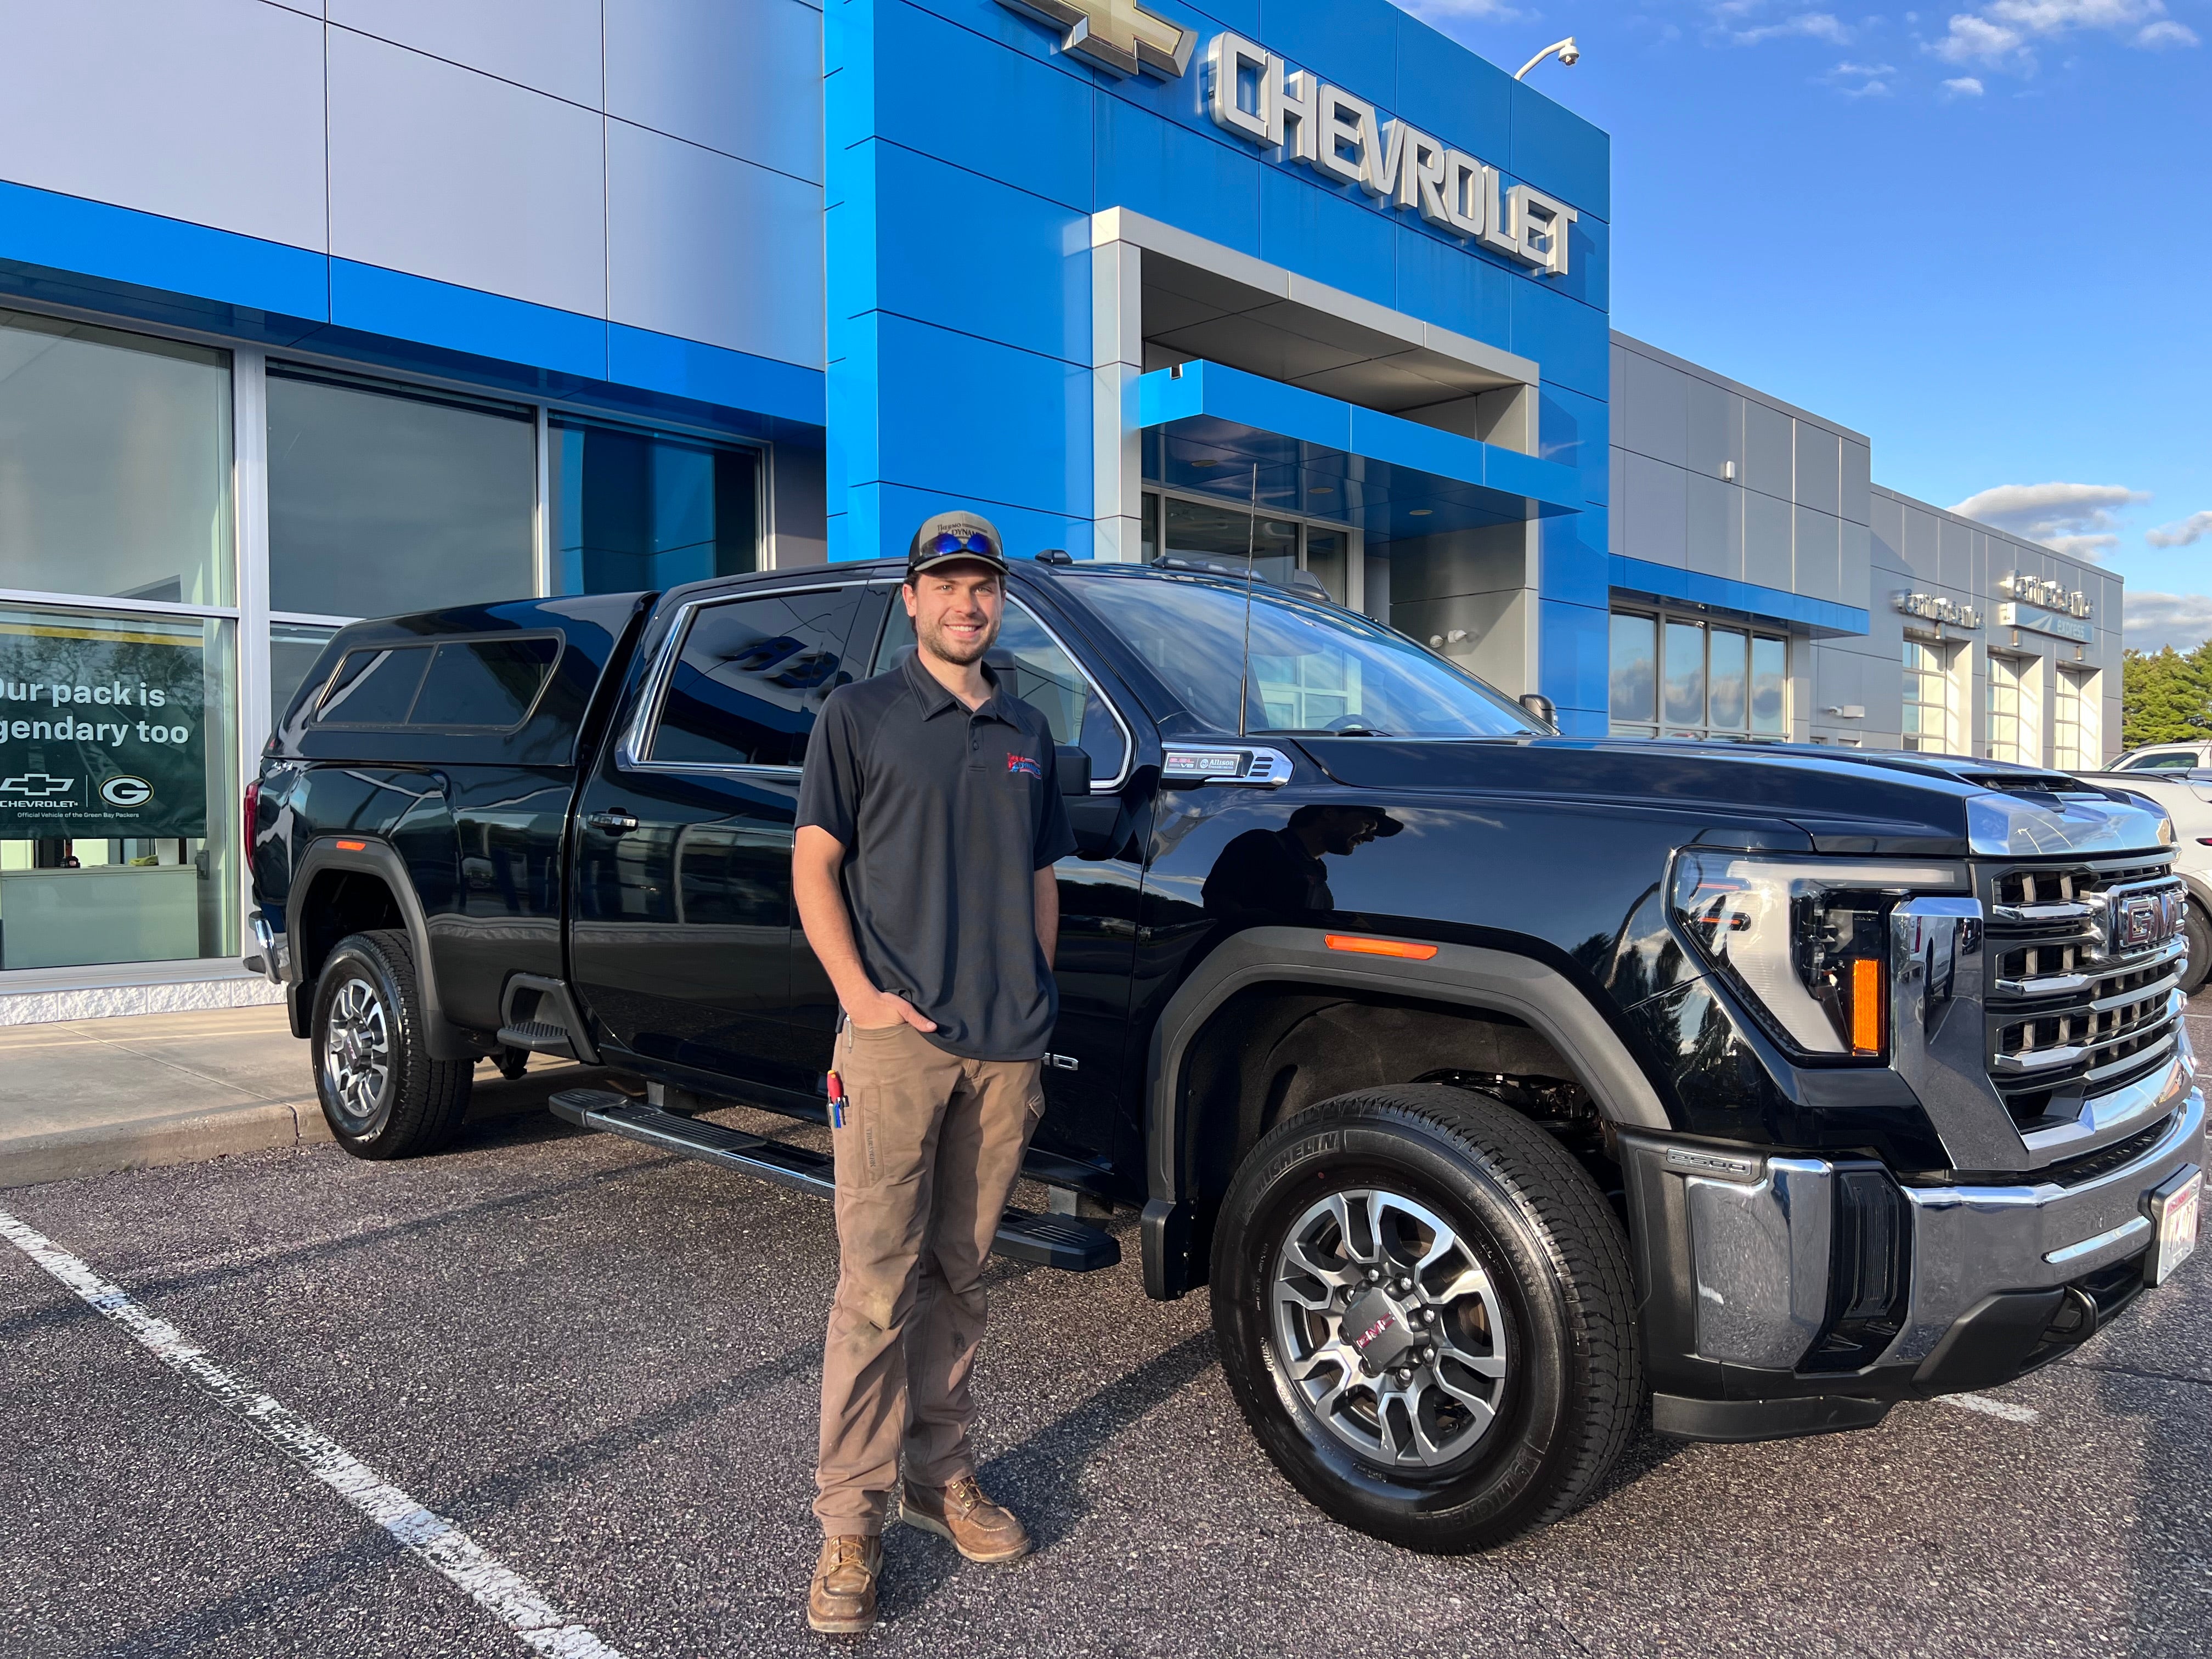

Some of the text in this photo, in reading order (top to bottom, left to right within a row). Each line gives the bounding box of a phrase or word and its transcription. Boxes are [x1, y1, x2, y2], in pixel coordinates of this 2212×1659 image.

[1207, 31, 1578, 275] CHEVROLET
[2058, 619, 2085, 637] express
[0, 678, 166, 708] ur pack is
[137, 720, 189, 744] too
[2121, 889, 2185, 948] GMC
[1356, 1310, 1396, 1350] GMC
